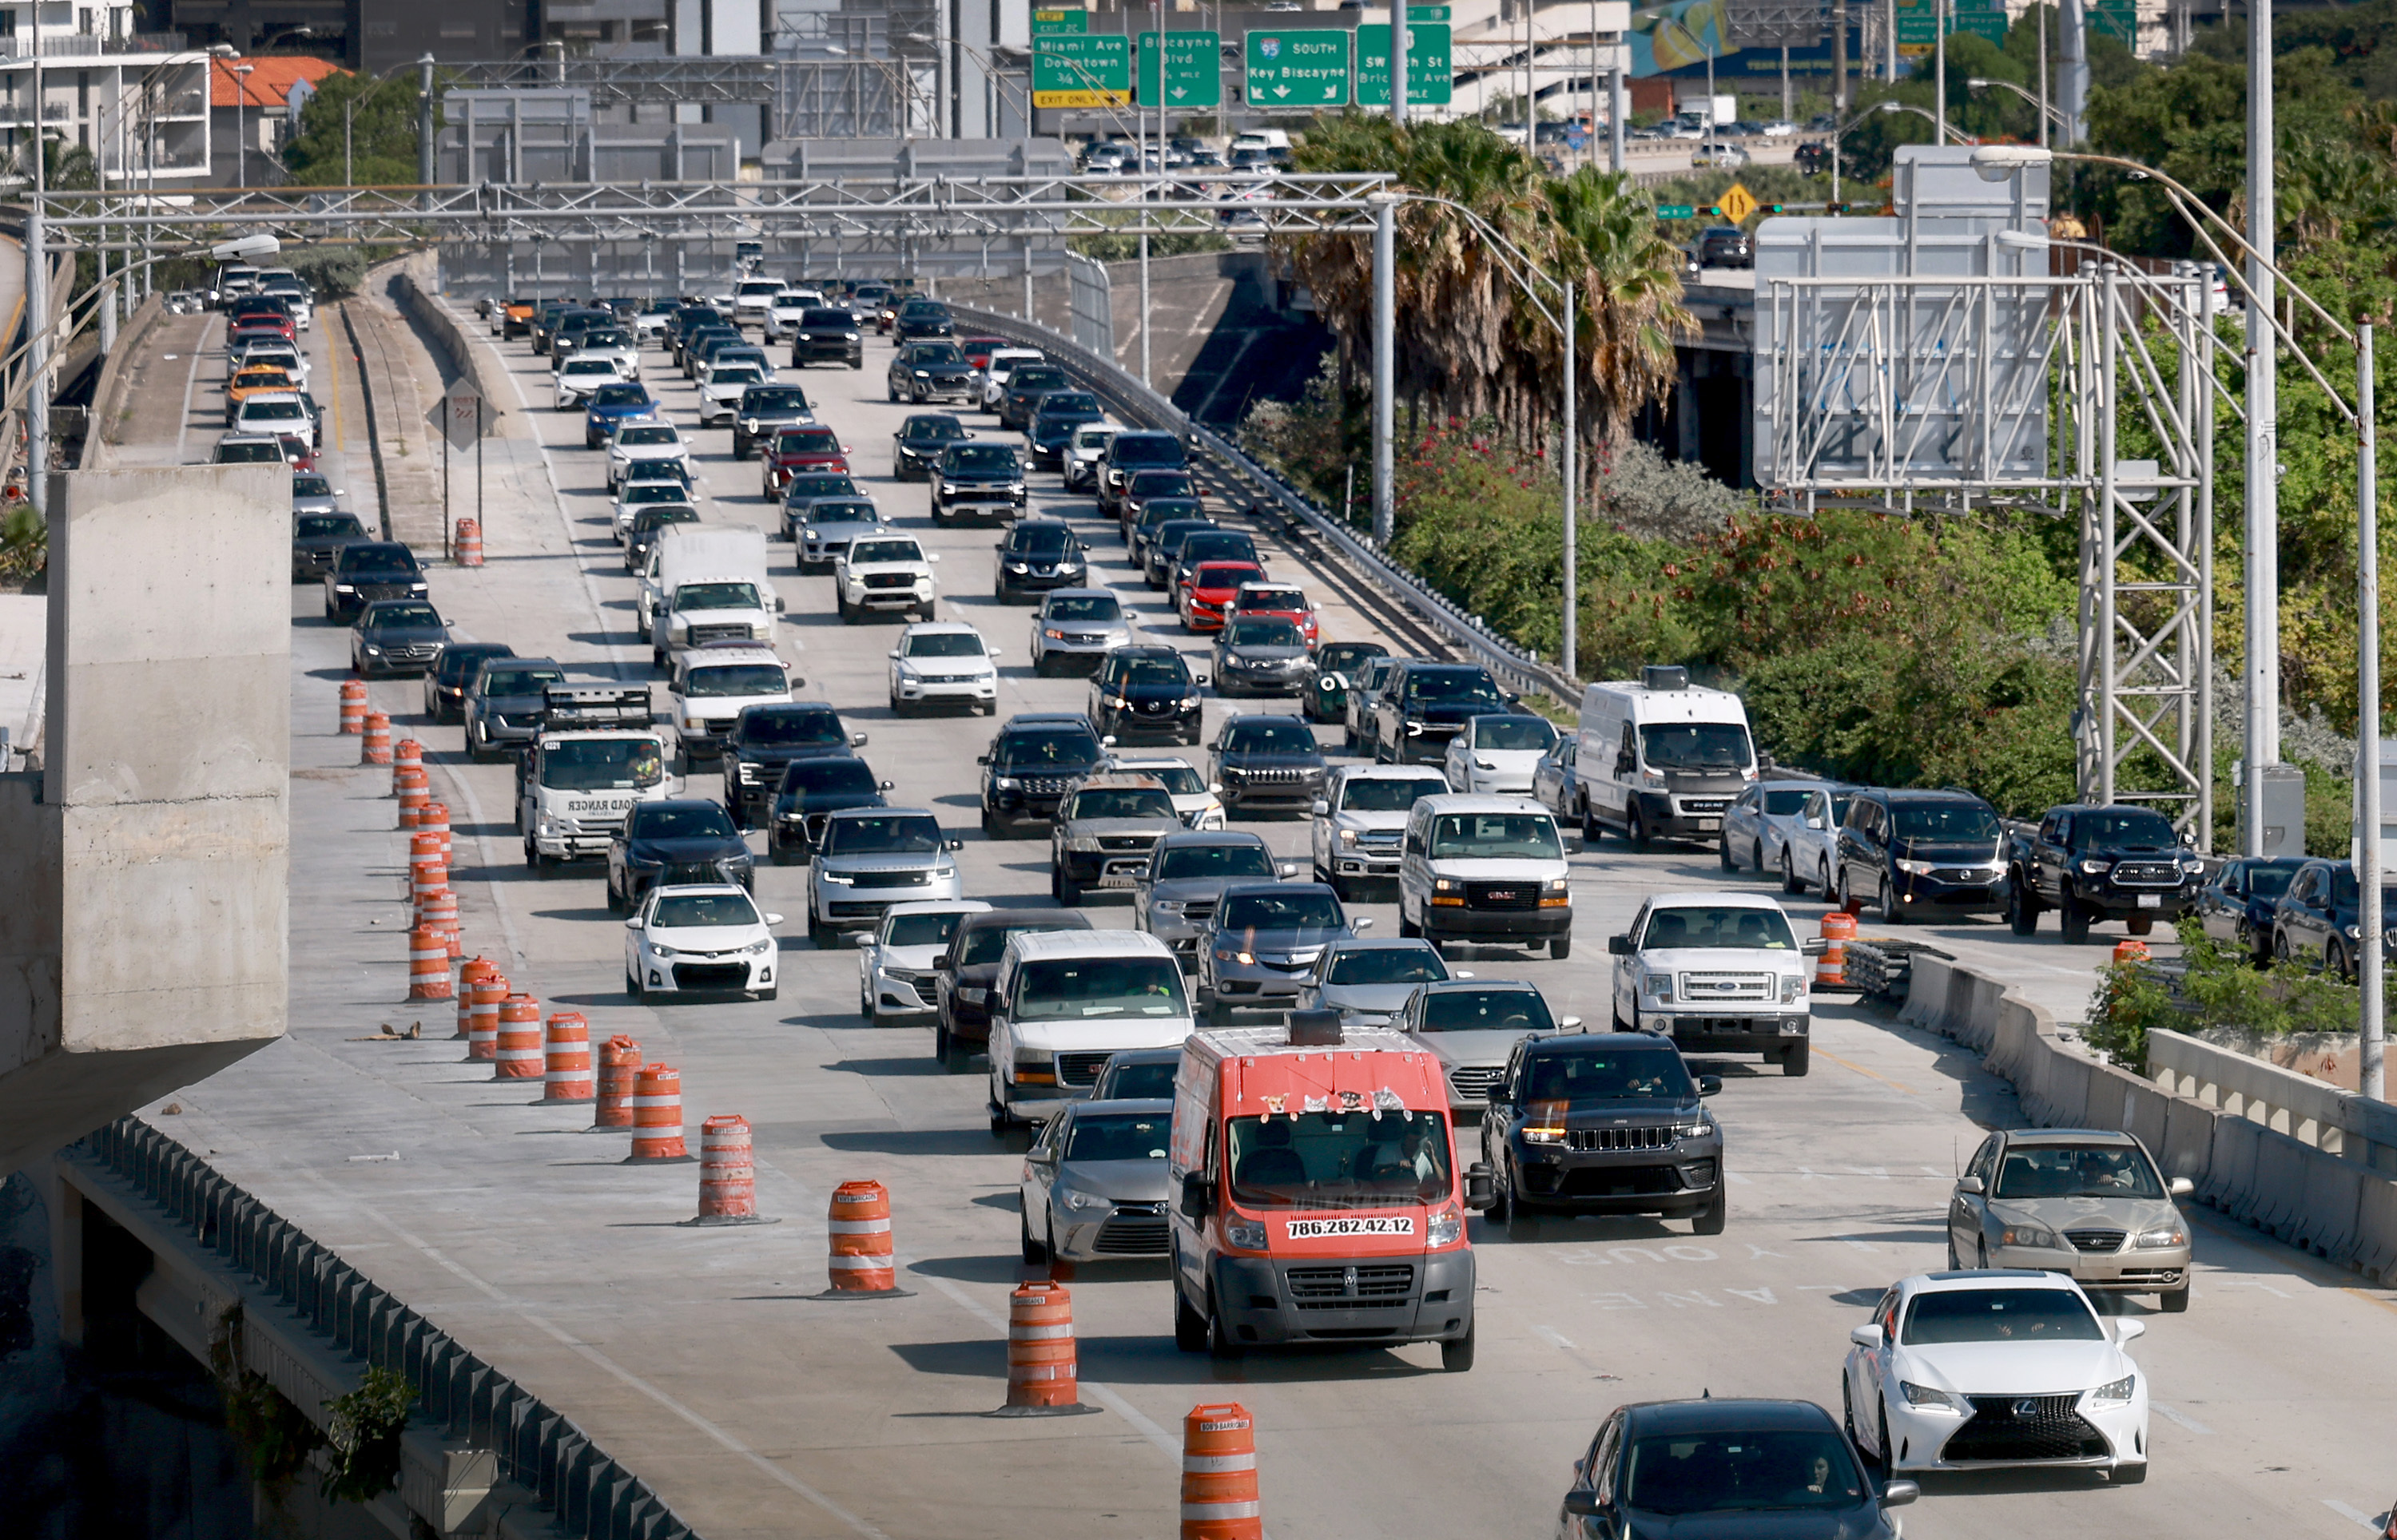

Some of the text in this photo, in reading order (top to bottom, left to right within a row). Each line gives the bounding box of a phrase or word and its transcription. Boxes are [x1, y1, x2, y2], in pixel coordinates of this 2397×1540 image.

[1039, 40, 1122, 52] Miami Ave
[1261, 42, 1337, 57] 95 SOUTH
[1044, 57, 1119, 68] Downtown
[1365, 56, 1385, 68] SW
[1427, 56, 1442, 67] St
[1249, 66, 1346, 81] Key Biscayne
[1424, 73, 1450, 83] Ave
[1288, 1219, 1411, 1237] 786.282.42.12
[1202, 1420, 1248, 1431] BOB'S BARRICADES
